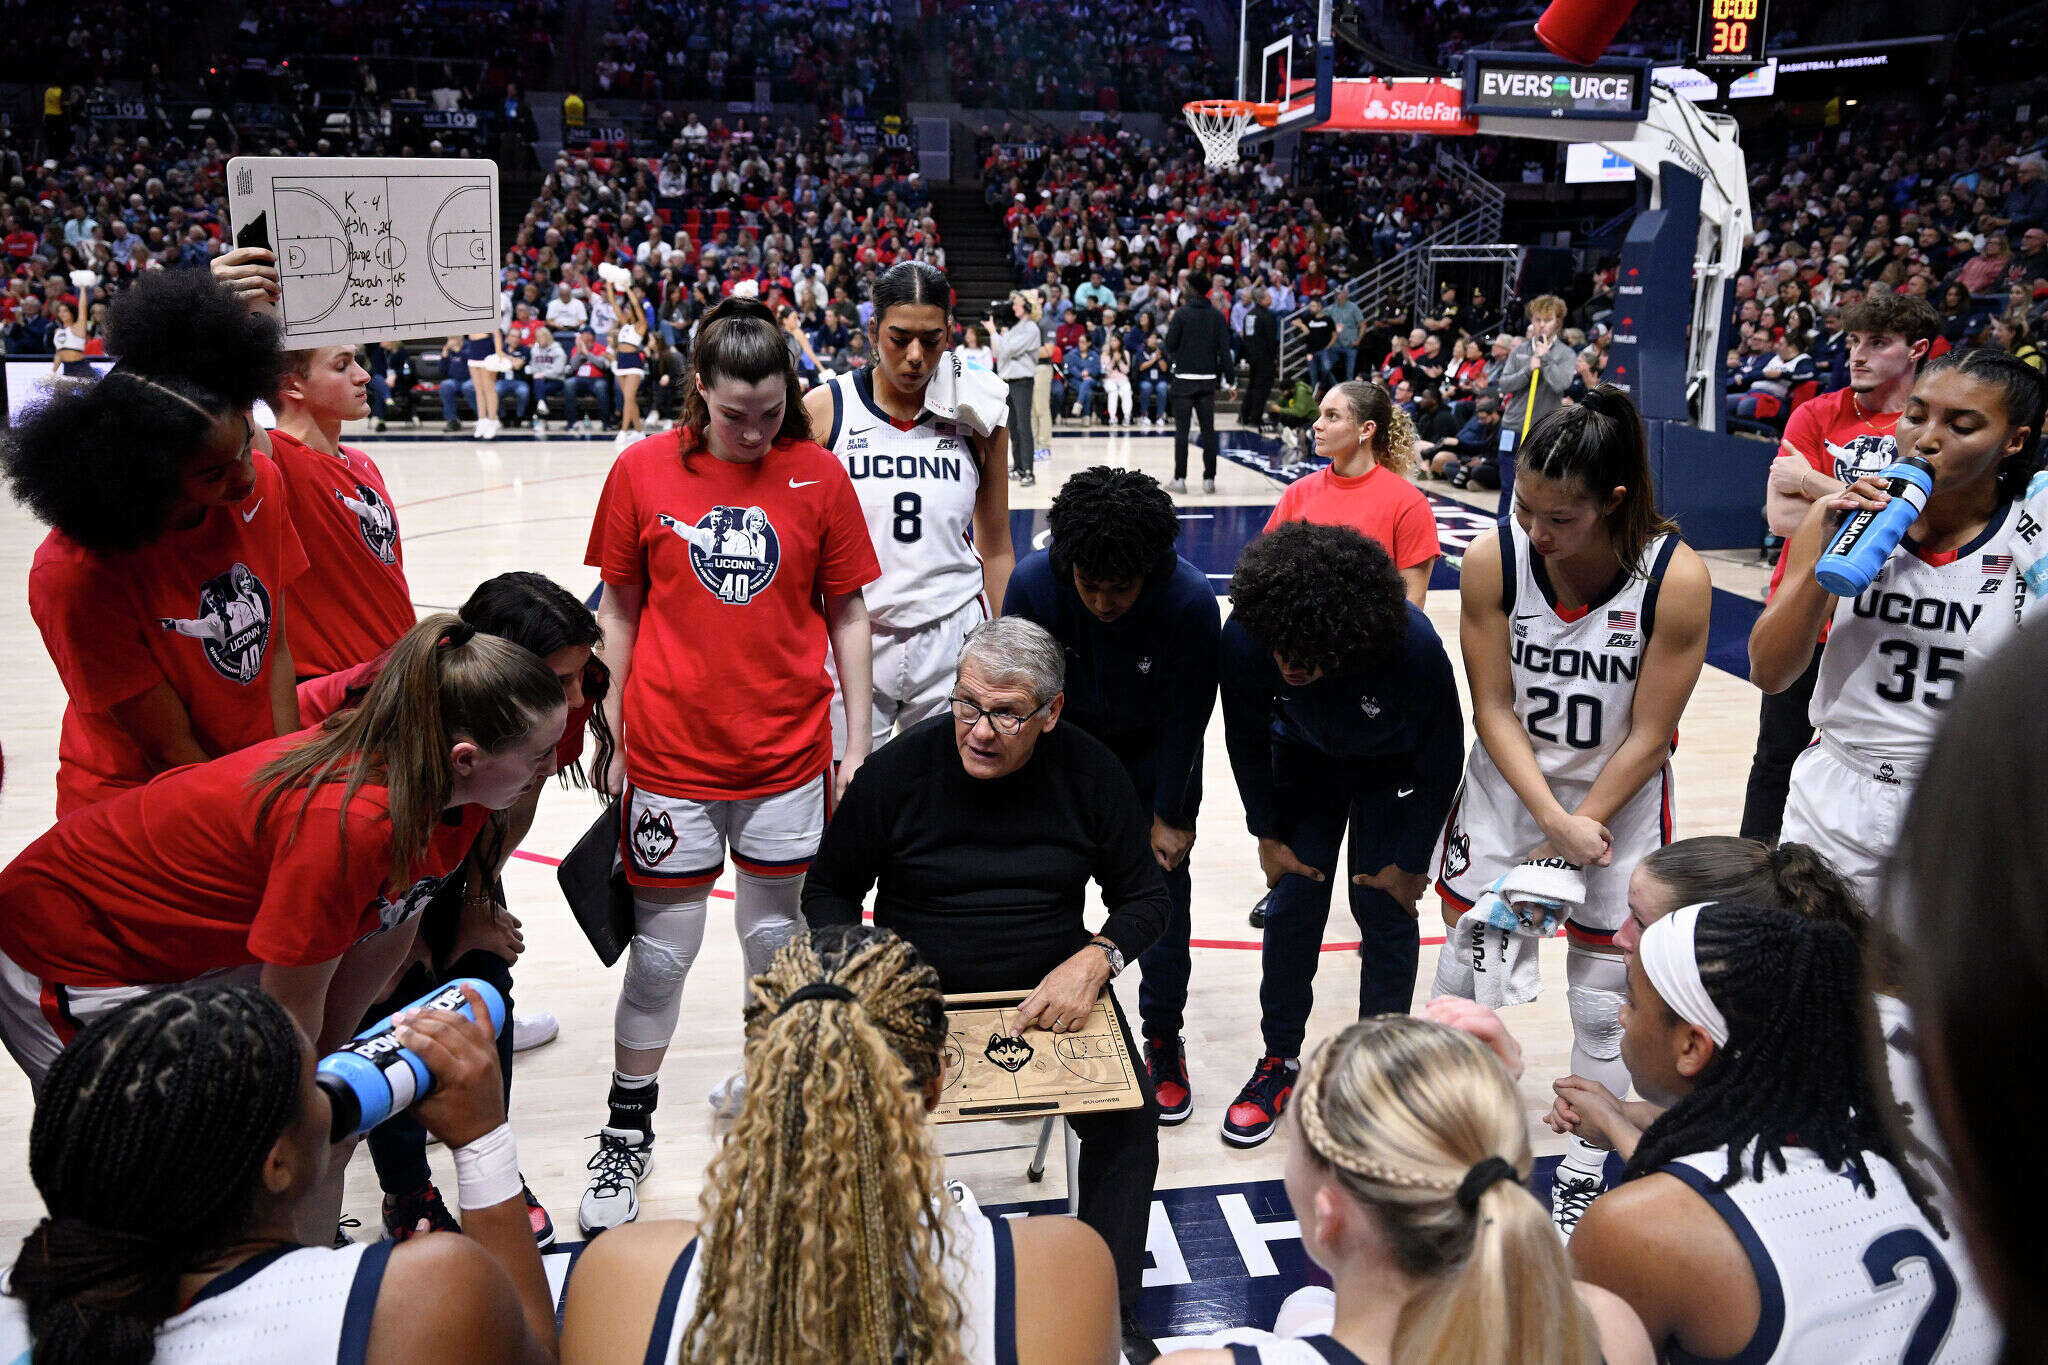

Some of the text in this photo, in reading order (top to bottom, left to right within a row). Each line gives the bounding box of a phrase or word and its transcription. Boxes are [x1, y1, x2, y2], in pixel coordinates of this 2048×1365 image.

[1713, 22, 1748, 53] 30
[1778, 60, 1835, 74] BASKETBALL
[115, 103, 145, 116] 109
[445, 113, 477, 127] 109
[599, 127, 626, 142] 110
[884, 133, 908, 147] 110
[345, 191, 357, 213] K
[849, 455, 960, 483] UCONN
[893, 491, 922, 544] 8
[715, 558, 755, 570] UCONN
[719, 573, 750, 600] 40
[230, 626, 260, 652] UCONN
[1607, 639, 1639, 648] EAST
[1611, 632, 1634, 641] BIG
[240, 644, 260, 680] 40
[1876, 639, 1965, 709] 35
[1527, 686, 1603, 750] 20
[1873, 774, 1901, 785] UCONN
